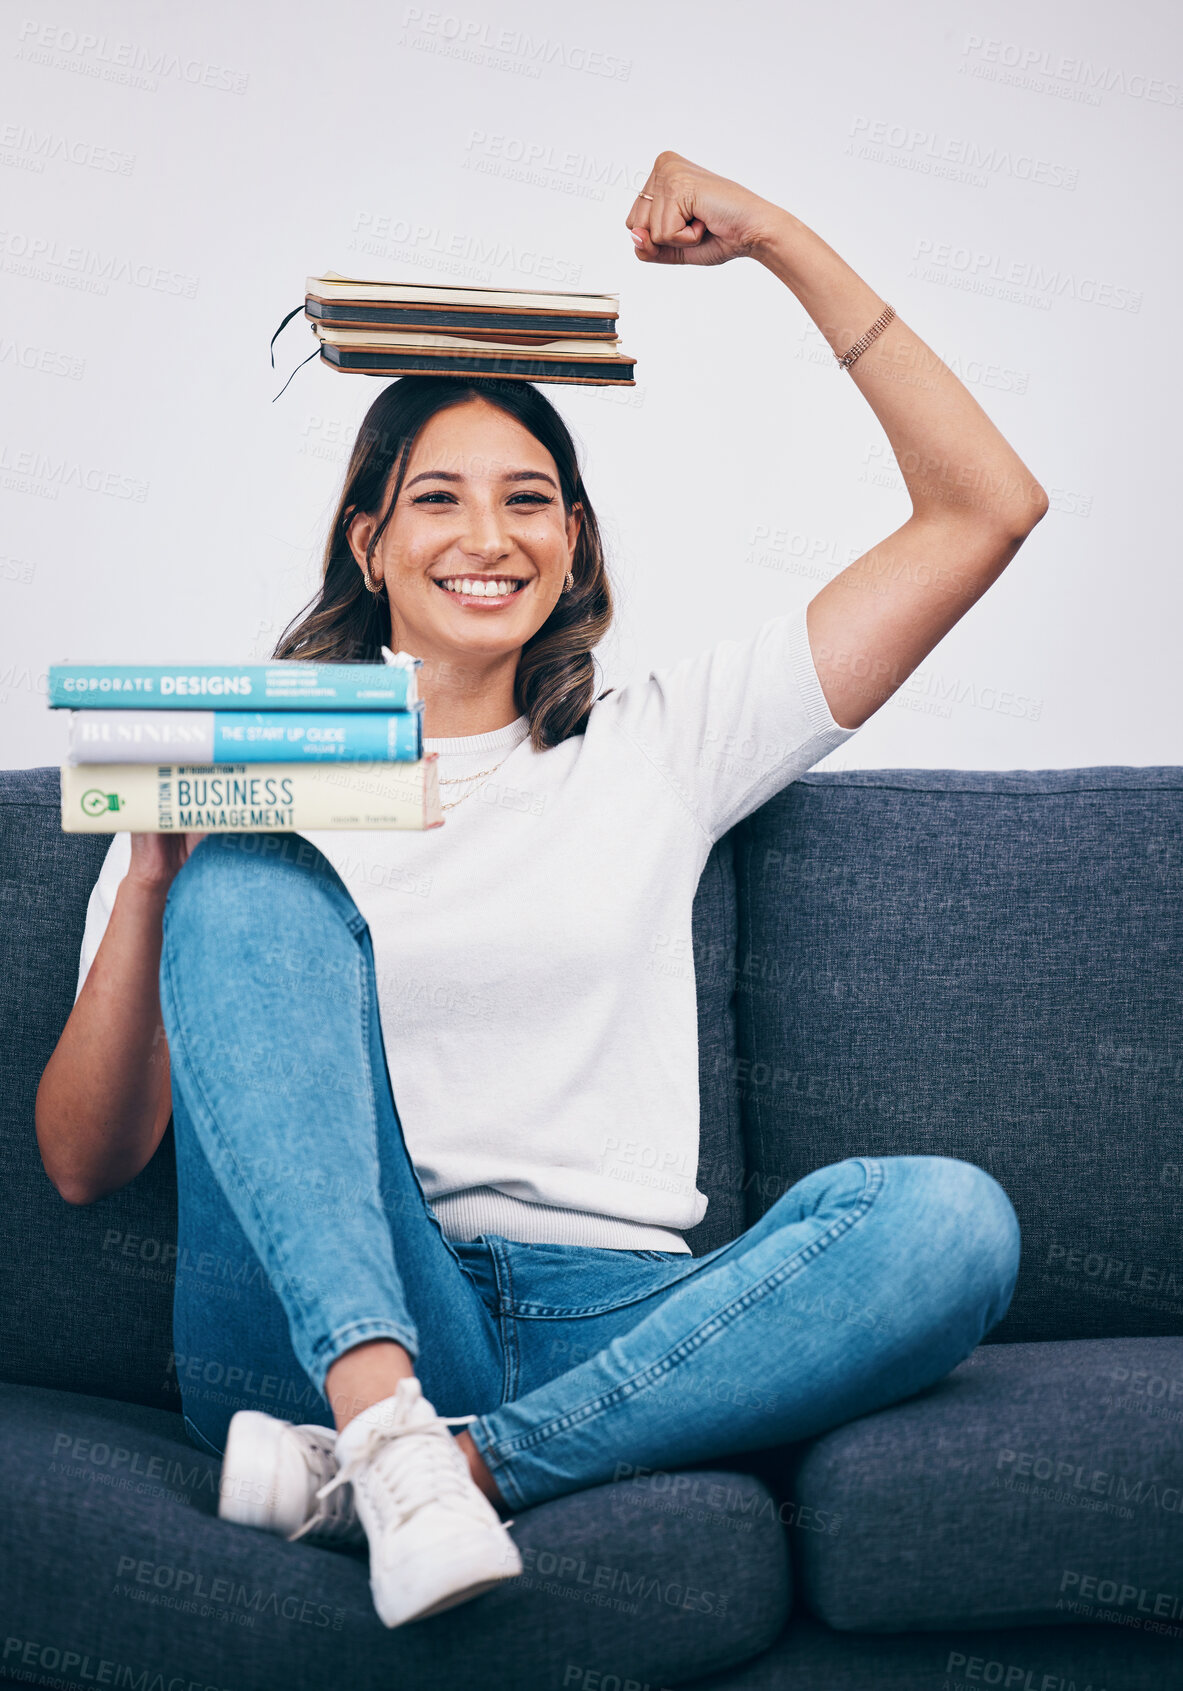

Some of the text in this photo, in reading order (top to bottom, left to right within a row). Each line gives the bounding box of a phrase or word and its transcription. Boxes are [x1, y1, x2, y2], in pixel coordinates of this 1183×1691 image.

[63, 677, 153, 692] COPORATE
[160, 675, 252, 696] DESIGNS
[81, 722, 207, 743] BUSINESS
[221, 726, 244, 741] THE
[287, 727, 305, 742] UP
[178, 778, 293, 806] BUSINESS
[179, 809, 294, 828] MANAGEMENT
